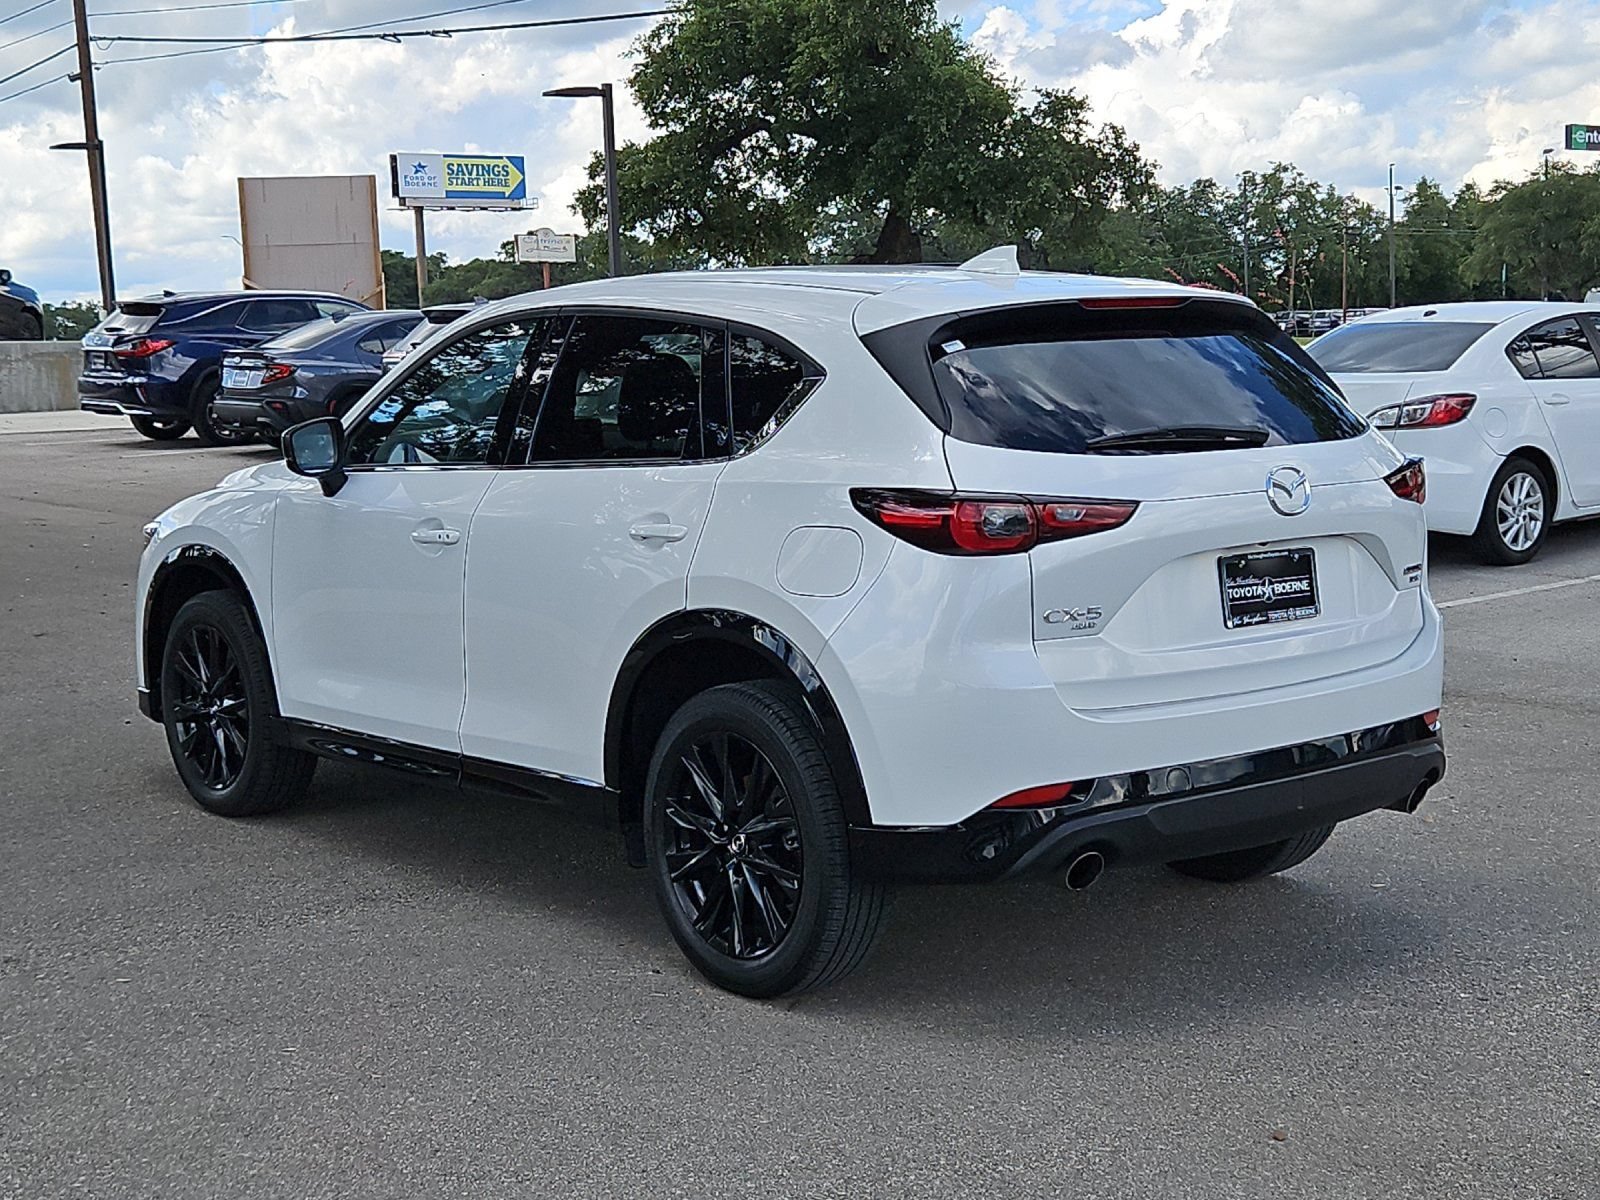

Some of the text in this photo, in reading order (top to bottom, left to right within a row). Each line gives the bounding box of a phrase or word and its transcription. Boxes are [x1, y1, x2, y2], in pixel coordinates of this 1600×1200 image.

[1572, 130, 1600, 143] ent
[446, 163, 510, 178] SAVINGS
[447, 176, 510, 187] START HERE
[1227, 580, 1310, 599] TOYOTA BOERNE
[1043, 605, 1102, 624] CX-5
